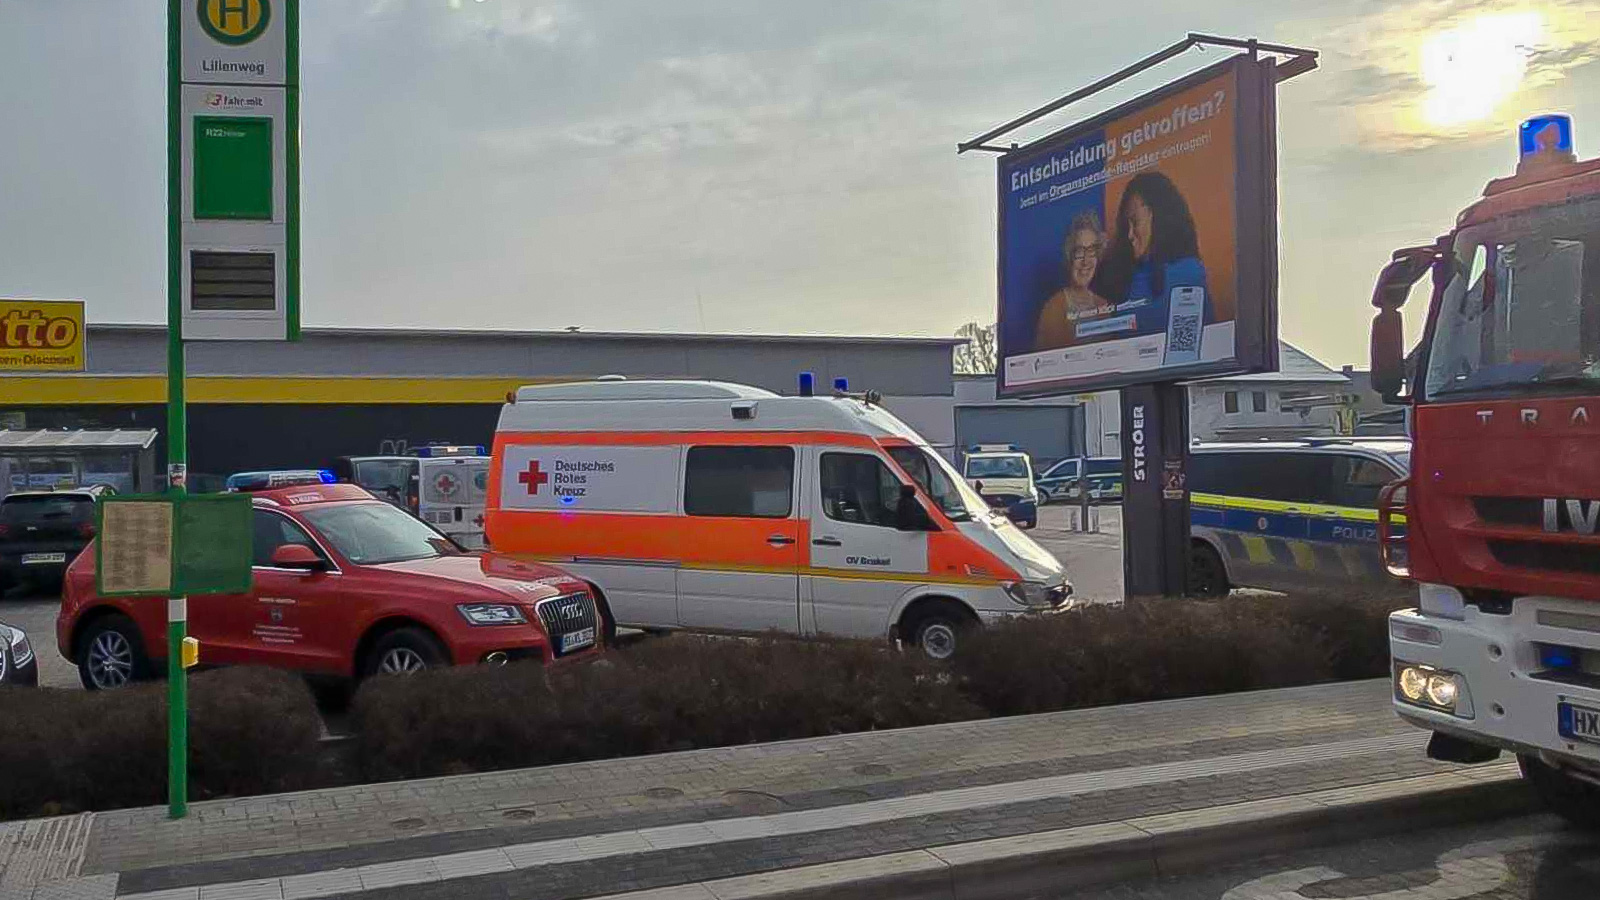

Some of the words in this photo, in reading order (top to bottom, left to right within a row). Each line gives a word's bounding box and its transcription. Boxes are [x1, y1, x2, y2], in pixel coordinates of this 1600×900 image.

[202, 59, 265, 75] Lilienweg
[1011, 138, 1117, 191] Entscheidung
[1120, 91, 1226, 154] getroffen?
[1132, 405, 1145, 481] STROER
[555, 460, 615, 472] Deutsches
[554, 473, 586, 484] Rotes
[553, 485, 586, 496] Kreuz
